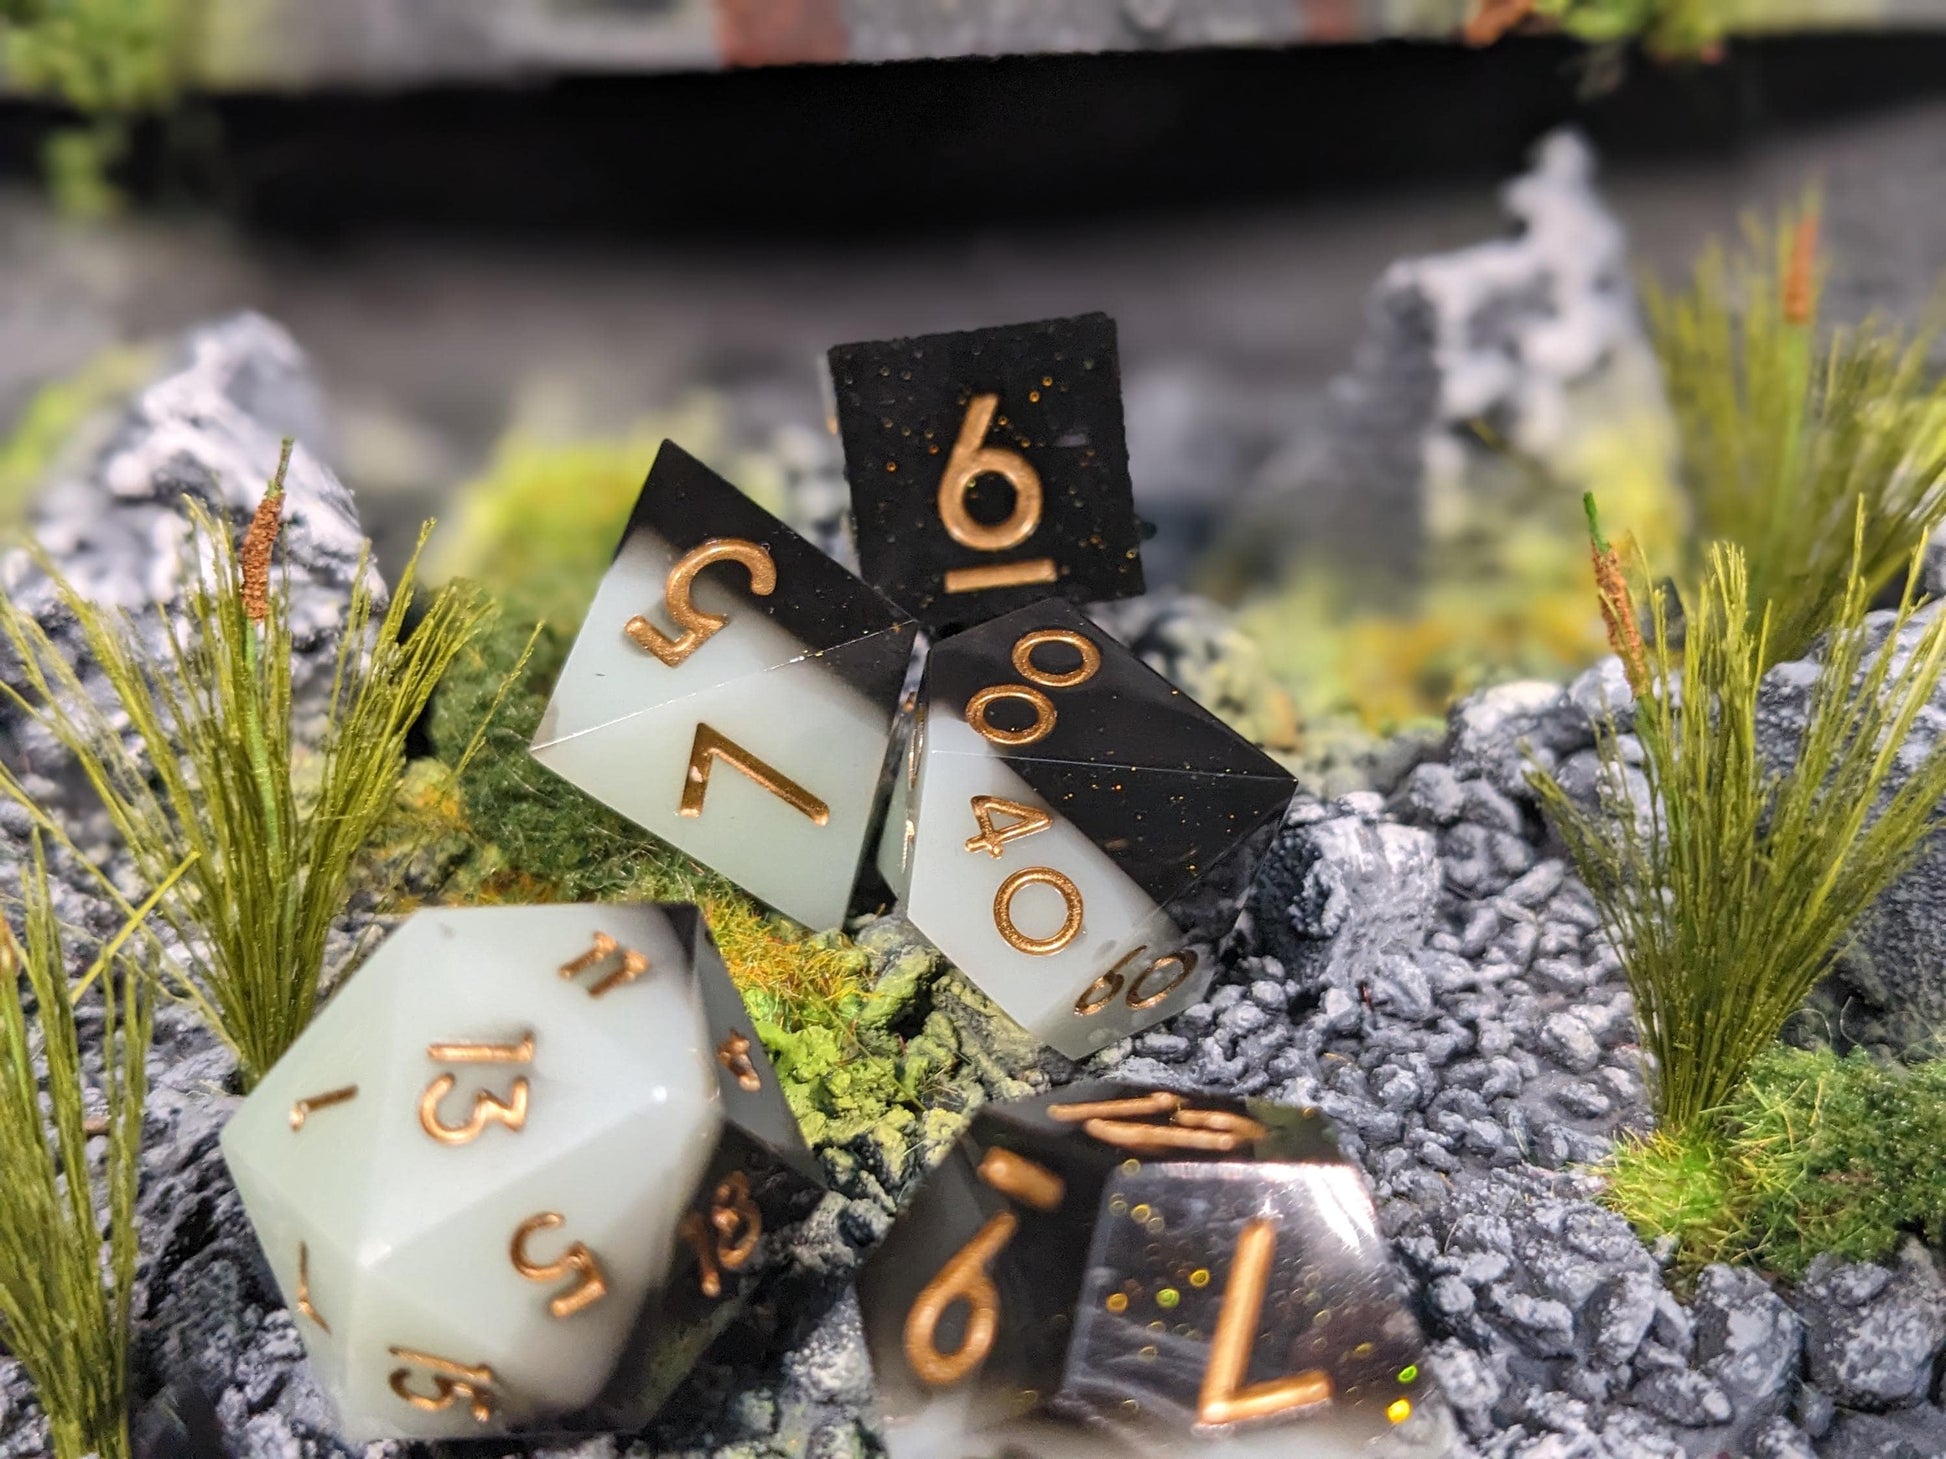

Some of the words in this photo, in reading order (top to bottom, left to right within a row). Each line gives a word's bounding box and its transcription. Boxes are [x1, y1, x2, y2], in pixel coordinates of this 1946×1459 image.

[937, 394, 1044, 551] 6
[624, 537, 778, 668] 5
[965, 629, 1101, 745] 00
[678, 722, 830, 827] 7
[964, 795, 1086, 957] 40
[1074, 947, 1198, 1018] 60
[420, 1030, 536, 1145] 13
[511, 1211, 606, 1318] 5
